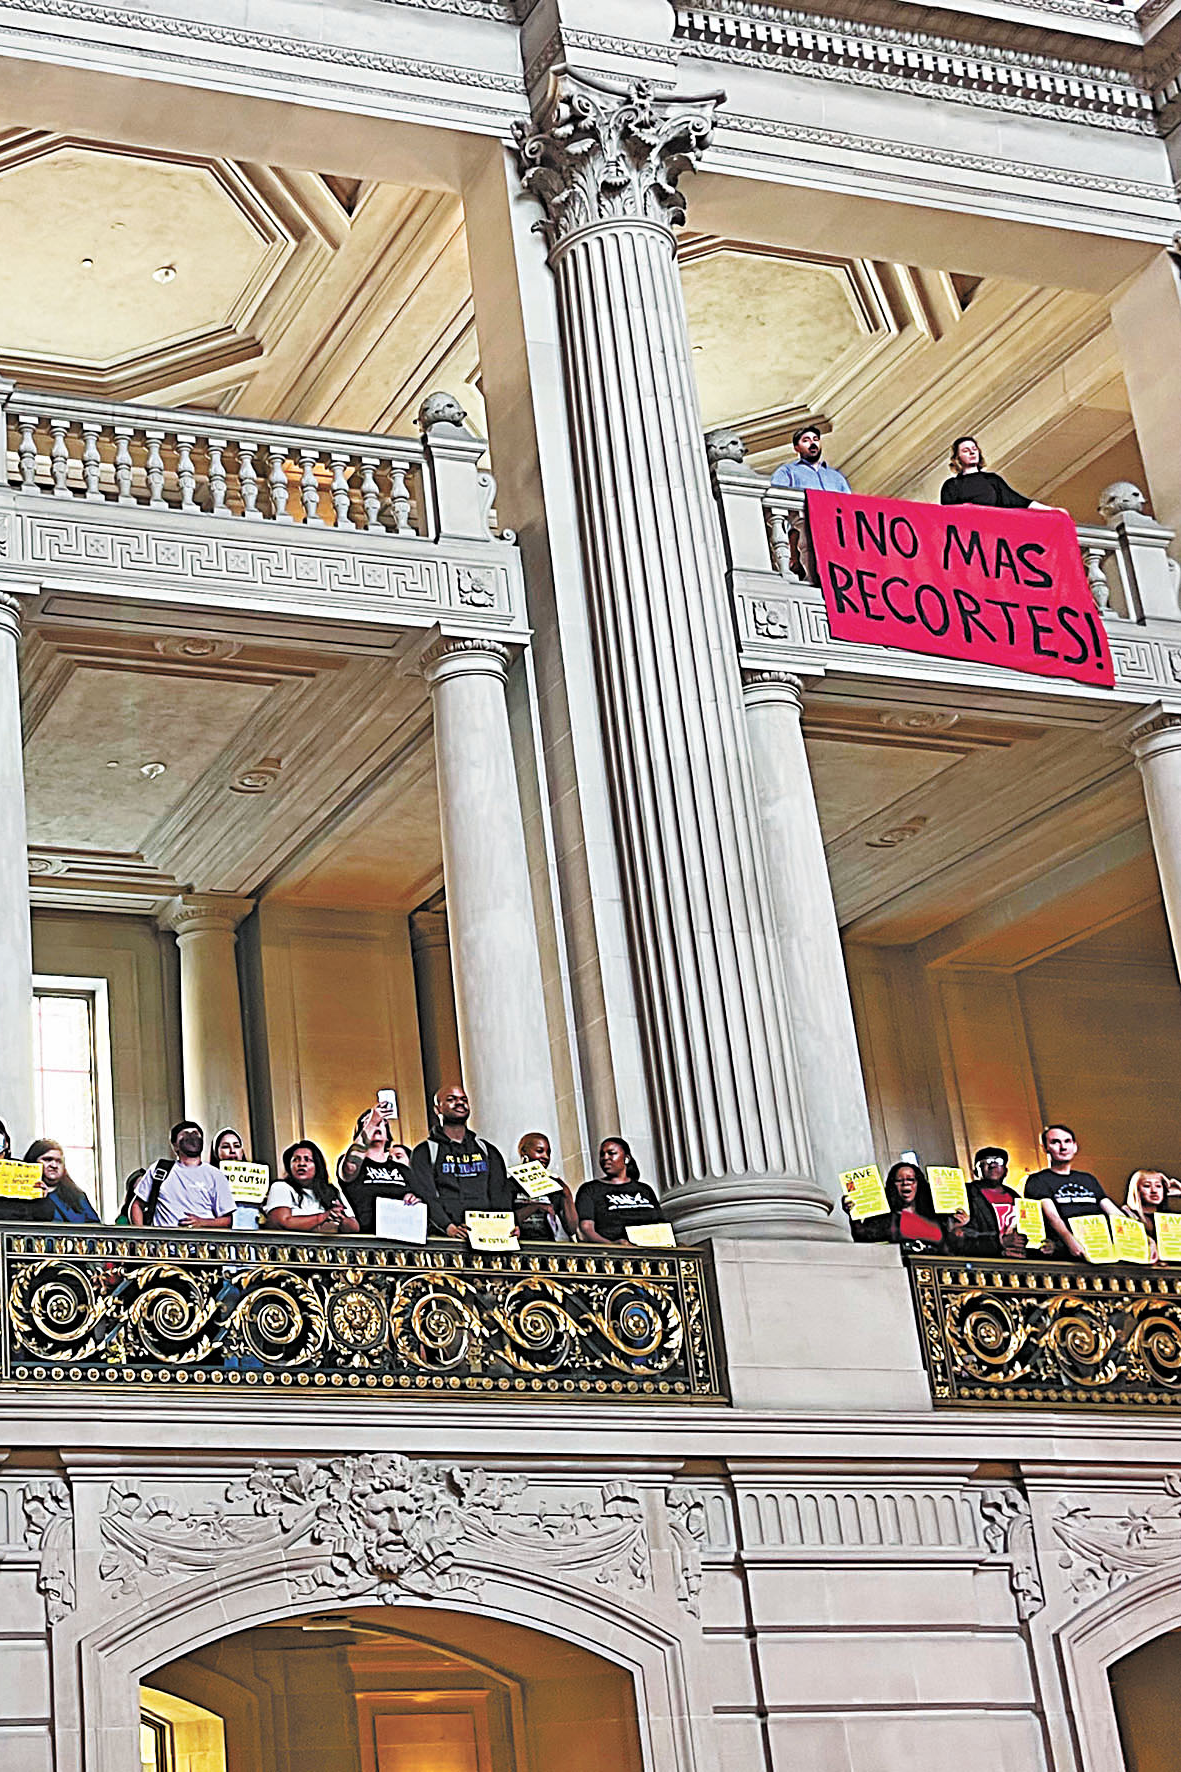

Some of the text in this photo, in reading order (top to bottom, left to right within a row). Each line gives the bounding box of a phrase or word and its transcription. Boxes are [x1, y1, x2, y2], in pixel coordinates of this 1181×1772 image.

[836, 508, 1053, 588] ¡NO MAS
[828, 561, 1104, 670] RECORTES!
[442, 1162, 456, 1173] BY
[933, 1168, 959, 1178] SAVE
[238, 1174, 266, 1185] CUTS!!
[845, 1168, 873, 1181] SAVE
